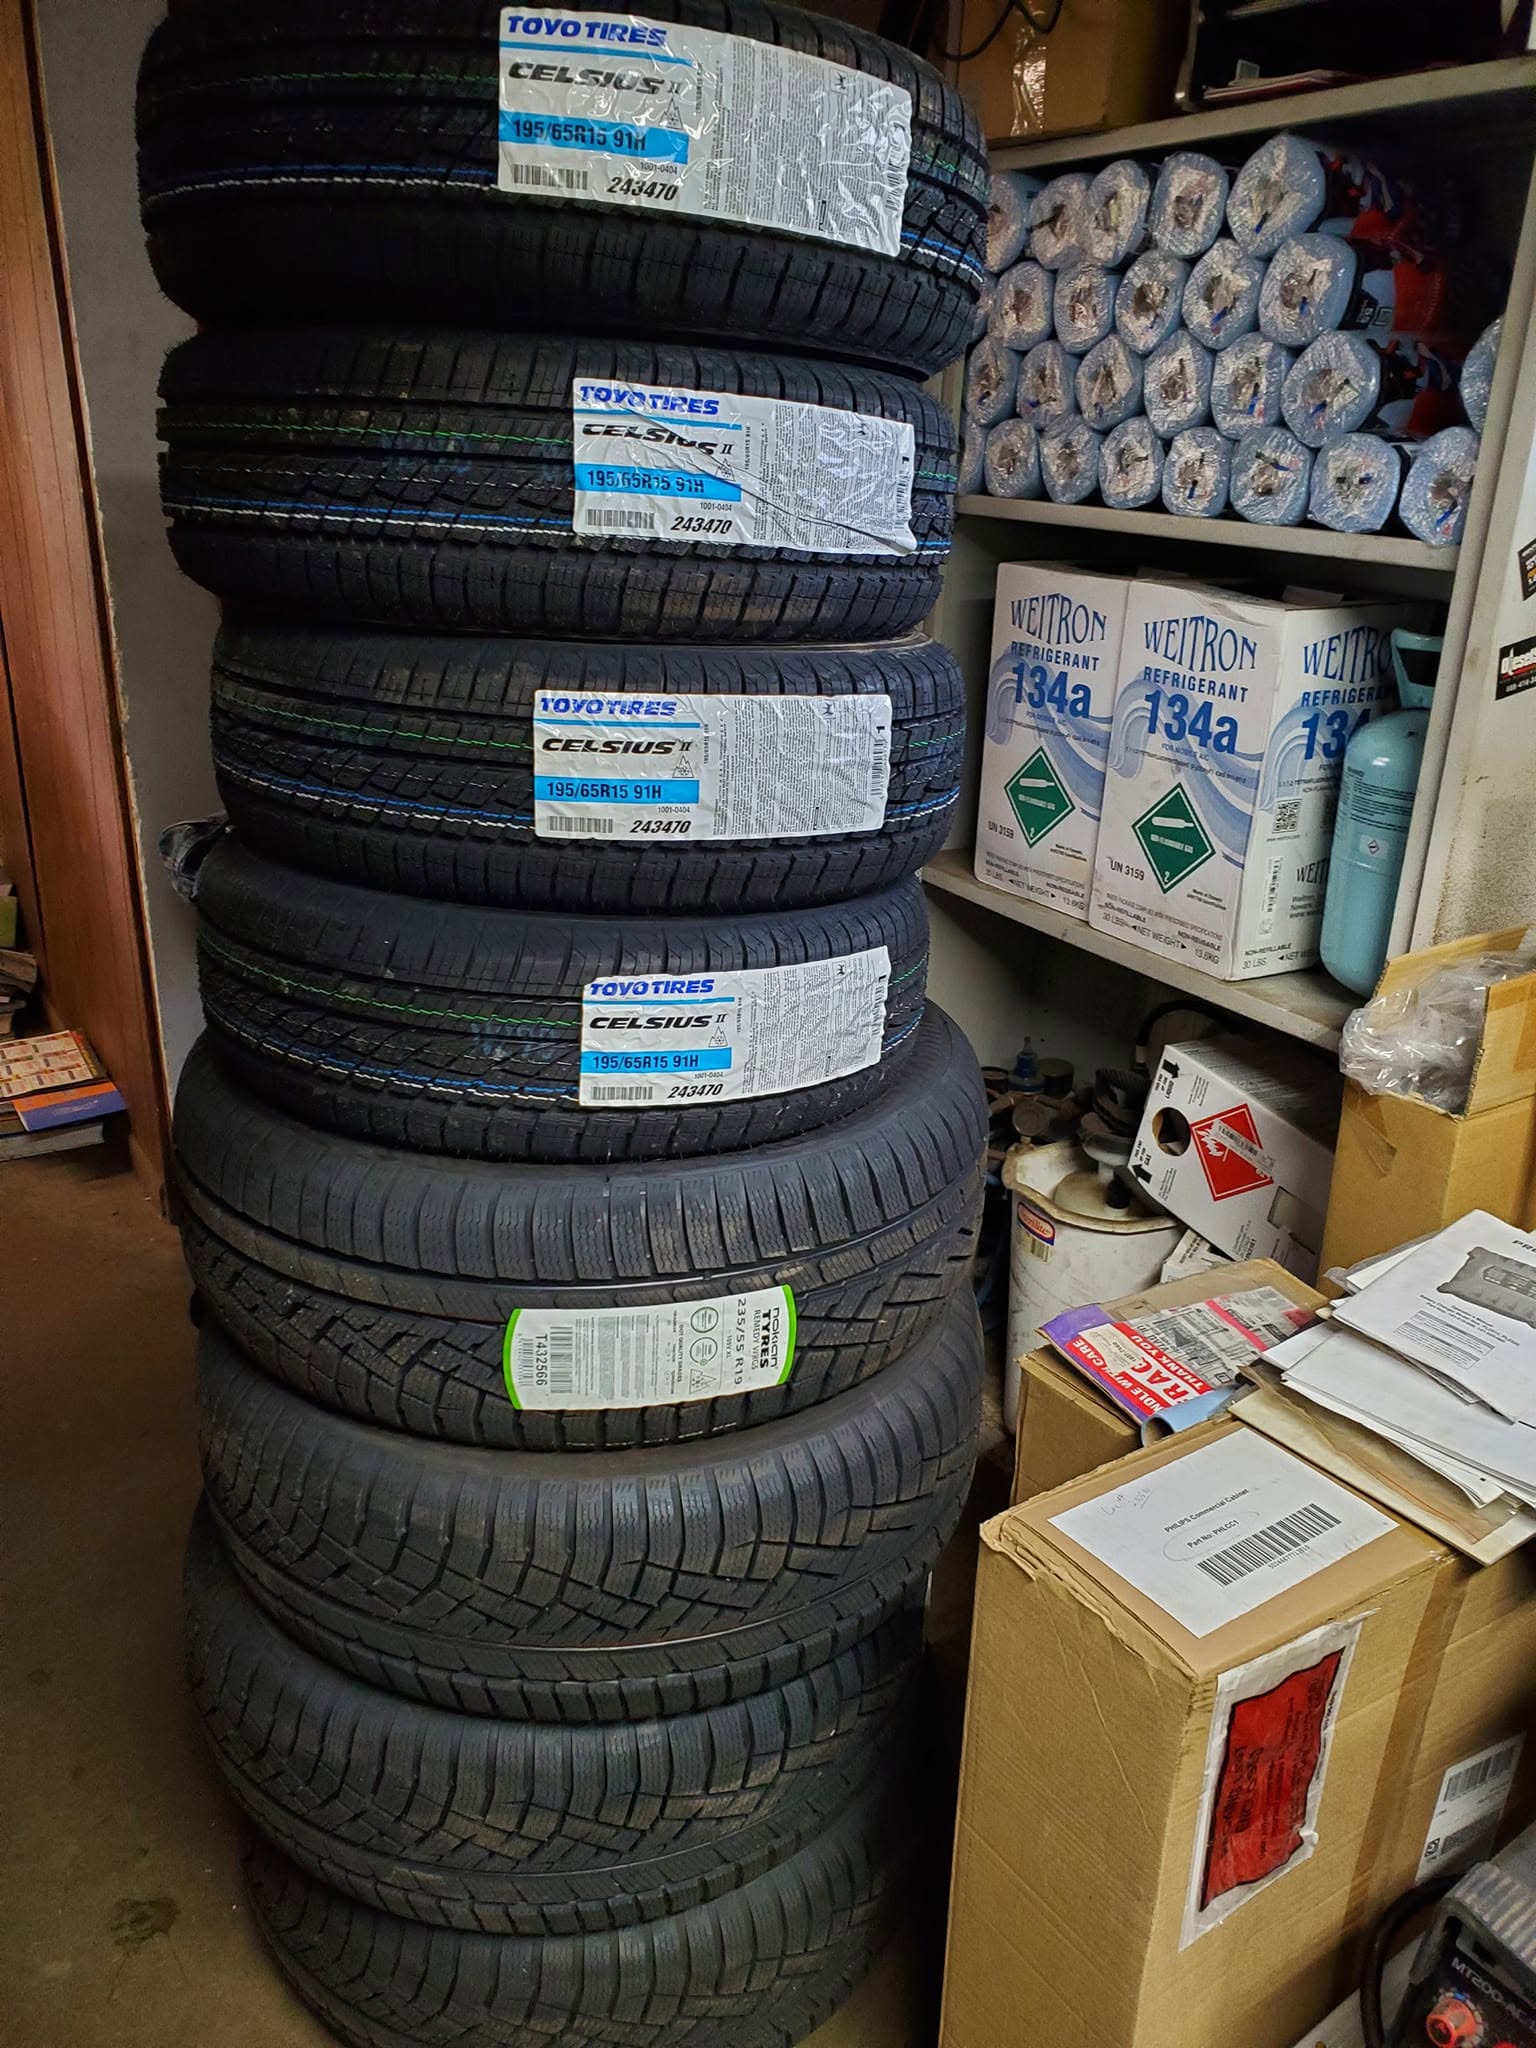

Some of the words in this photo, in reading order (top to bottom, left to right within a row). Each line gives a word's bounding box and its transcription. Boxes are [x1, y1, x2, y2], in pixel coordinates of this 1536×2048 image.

[508, 16, 581, 37] TOYO
[585, 22, 667, 46] TIRES
[509, 62, 665, 95] CELSIUS
[514, 119, 607, 146] 195/65R15
[614, 130, 646, 151] 91H
[640, 162, 678, 174] 1001-0404
[606, 176, 679, 201] 243470
[580, 385, 645, 408] TOYO
[648, 394, 719, 415] TIRES
[582, 424, 717, 455] CELSIUS
[587, 470, 670, 490] 195/65R15
[676, 477, 704, 493] 91H
[700, 502, 732, 511] 1001-0404
[670, 516, 733, 534] 243470
[1010, 593, 1107, 645] WEITRON
[1011, 641, 1100, 672] REFRIGERANT
[1144, 616, 1257, 673] WEITRON
[1012, 662, 1092, 720] 134a
[1143, 666, 1249, 703] REFRIGERANT
[541, 697, 604, 715] TOYO
[607, 700, 677, 716] TIRES
[1144, 690, 1238, 754] 134a
[542, 738, 676, 755] CELSIUS
[547, 782, 628, 799] 195/65R15
[634, 785, 662, 799] 91H
[658, 806, 690, 814] 1001-0404
[629, 820, 692, 834] 243470
[1110, 860, 1123, 873] UN
[1125, 865, 1145, 881] 3159
[1164, 871, 1170, 883] 2
[1152, 931, 1181, 948] WEIGHT
[590, 981, 649, 996] TOYO
[652, 979, 714, 994] TIRES
[589, 1015, 712, 1030] CELSIUS
[715, 1014, 728, 1023] II
[593, 1056, 668, 1070] 195/65R15
[673, 1055, 699, 1068] 91H
[667, 1083, 724, 1099] 243470
[735, 1297, 747, 1352] 235/55
[752, 1309, 761, 1344] REMEDY
[760, 1309, 771, 1369] TYRES
[771, 1307, 780, 1368] nokian
[535, 1333, 548, 1387] T432566
[1073, 1338, 1105, 1367] CARE
[1131, 1335, 1159, 1356] YOU
[734, 1356, 744, 1385] R19
[1159, 1355, 1205, 1390] THANK
[1164, 1517, 1191, 1534] PHILIPS
[1189, 1500, 1227, 1521] Commercial
[1225, 1488, 1249, 1504] Cabinet
[1187, 1538, 1203, 1549] Part
[1201, 1531, 1214, 1543] No:
